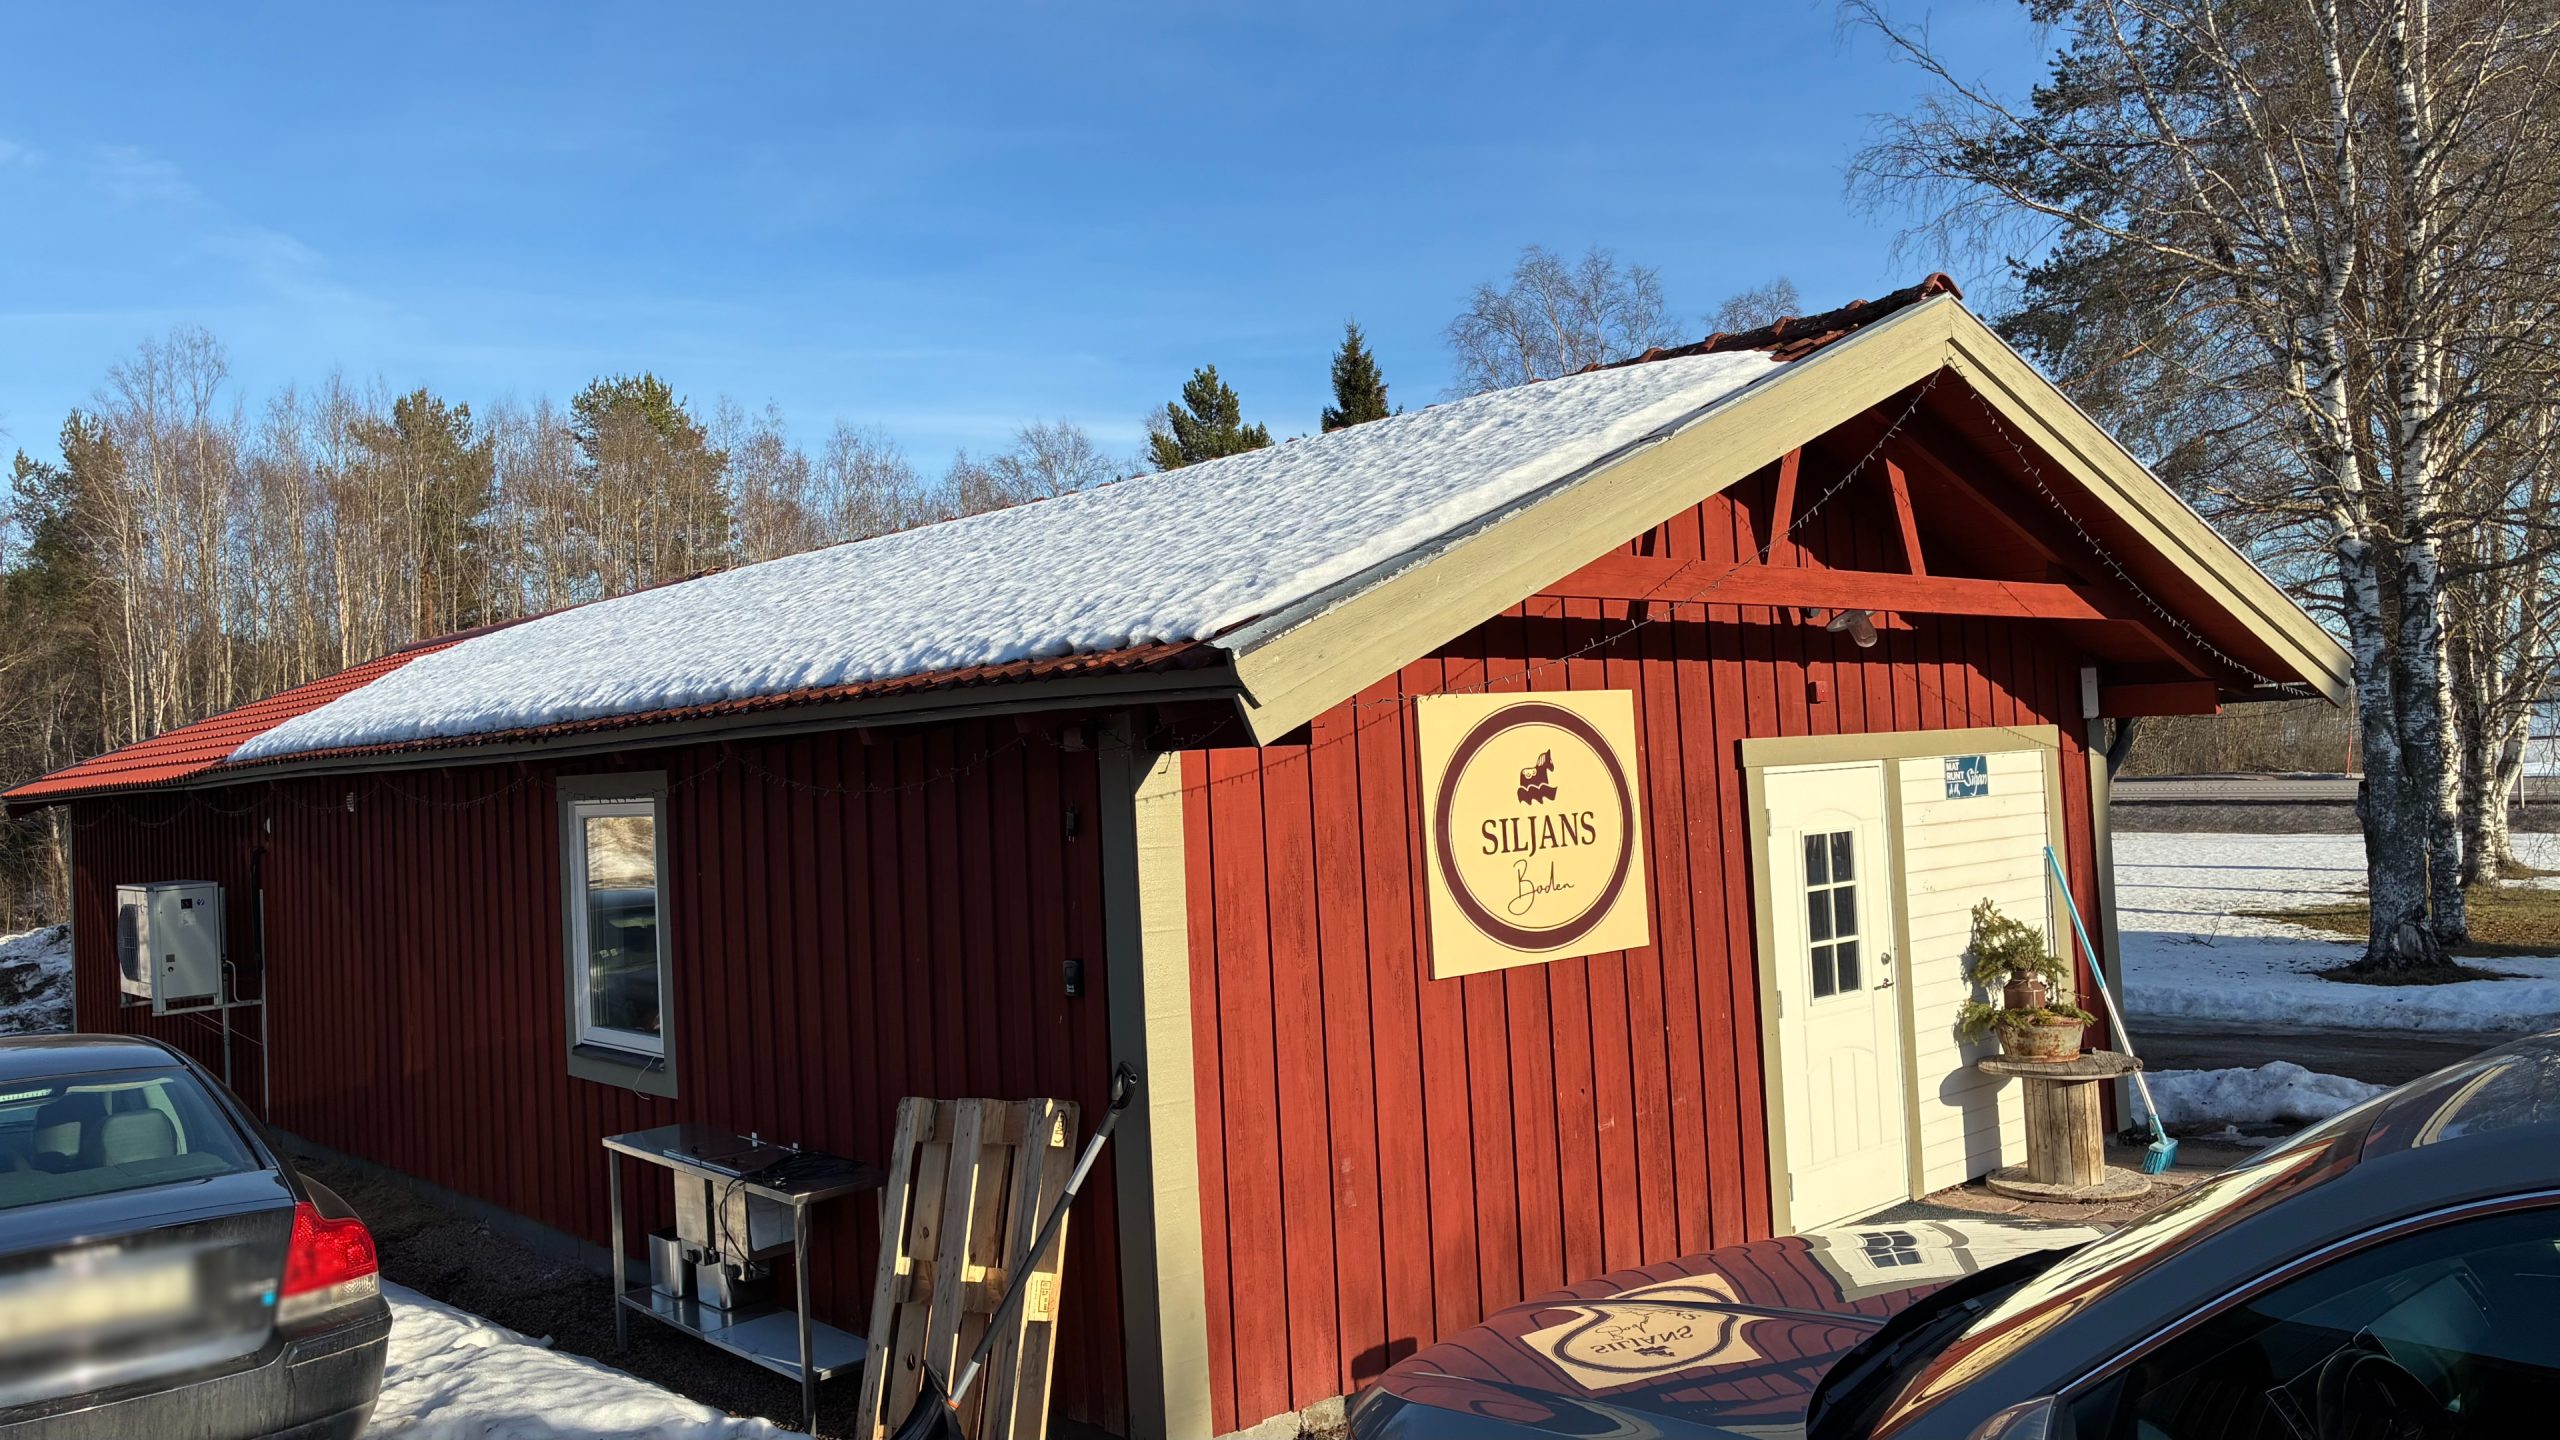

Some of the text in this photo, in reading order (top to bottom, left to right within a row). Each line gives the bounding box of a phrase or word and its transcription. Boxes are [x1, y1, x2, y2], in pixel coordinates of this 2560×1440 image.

[1946, 762, 1960, 771] MAT
[1946, 757, 1987, 796] RUNT Siljan
[1481, 811, 1596, 857] SILJANS
[1508, 859, 1575, 916] Boden
